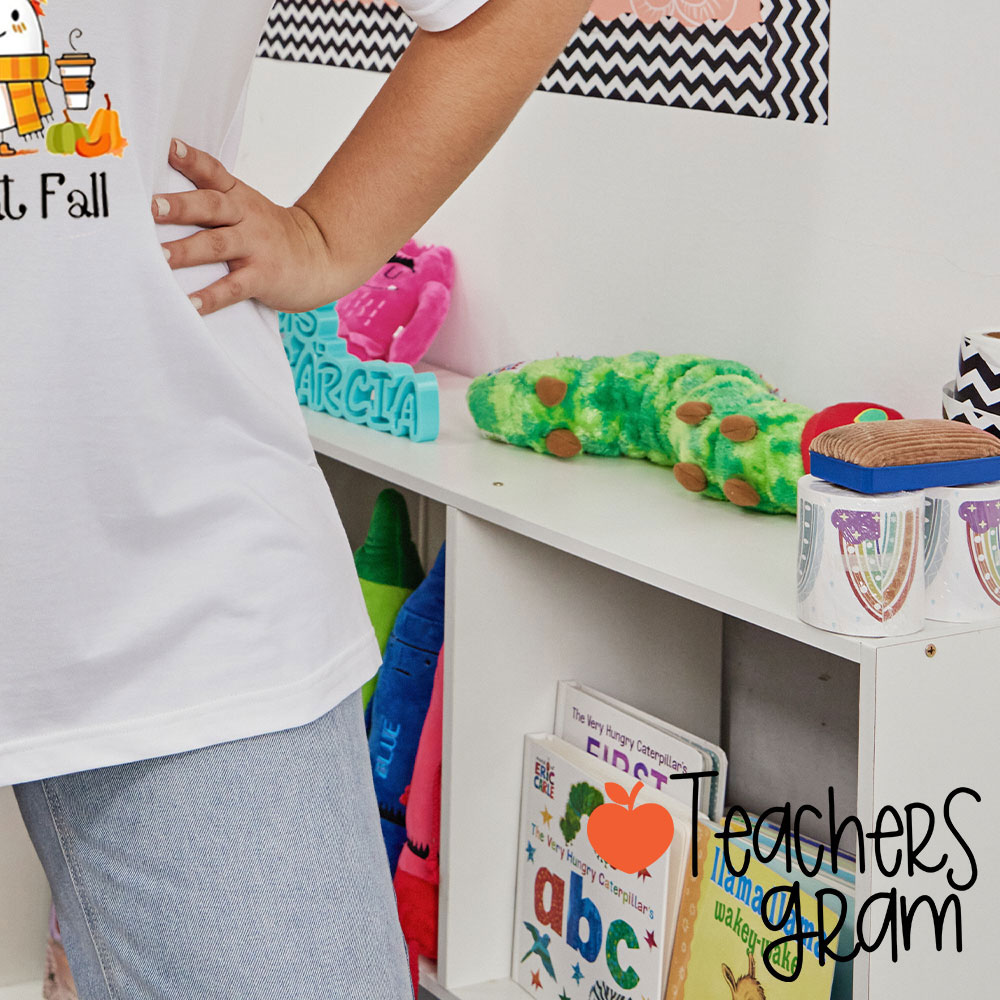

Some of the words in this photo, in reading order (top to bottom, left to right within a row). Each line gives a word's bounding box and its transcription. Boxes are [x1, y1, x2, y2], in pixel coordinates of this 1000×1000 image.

[41, 172, 109, 218] Fall
[375, 718, 401, 779] BLUE
[572, 706, 585, 724] The
[587, 714, 604, 735] Very
[606, 724, 635, 751] Hungry
[636, 740, 688, 774] Caterpillar's
[534, 776, 554, 800] CARLE
[535, 762, 555, 785] ERIC
[531, 822, 545, 842] The
[547, 834, 566, 860] Very
[566, 849, 597, 883] Hungry
[598, 872, 655, 920] Caterpillar's
[534, 866, 640, 990] abc
